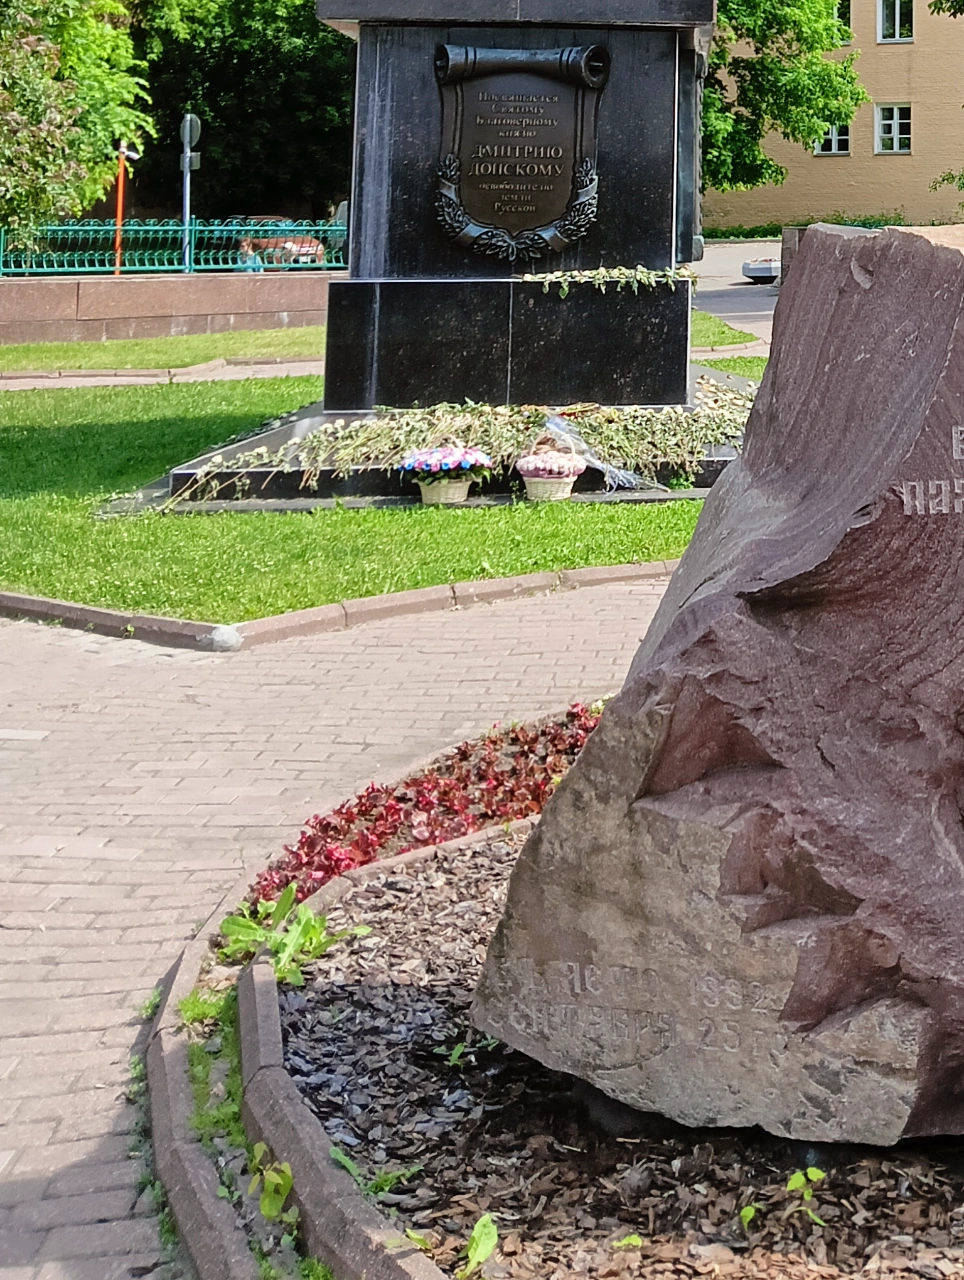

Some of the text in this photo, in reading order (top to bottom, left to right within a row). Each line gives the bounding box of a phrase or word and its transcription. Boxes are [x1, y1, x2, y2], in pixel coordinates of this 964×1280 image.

[478, 91, 559, 103] Посвящается
[491, 104, 545, 116] Святому
[476, 116, 559, 128] Благоверному
[499, 129, 537, 138] князю
[471, 144, 563, 159] ДМИТРИЮ
[468, 163, 565, 177] ДОНСКОМУ
[478, 181, 553, 191] освободителю
[501, 192, 531, 202] земли
[494, 202, 536, 215] Русской
